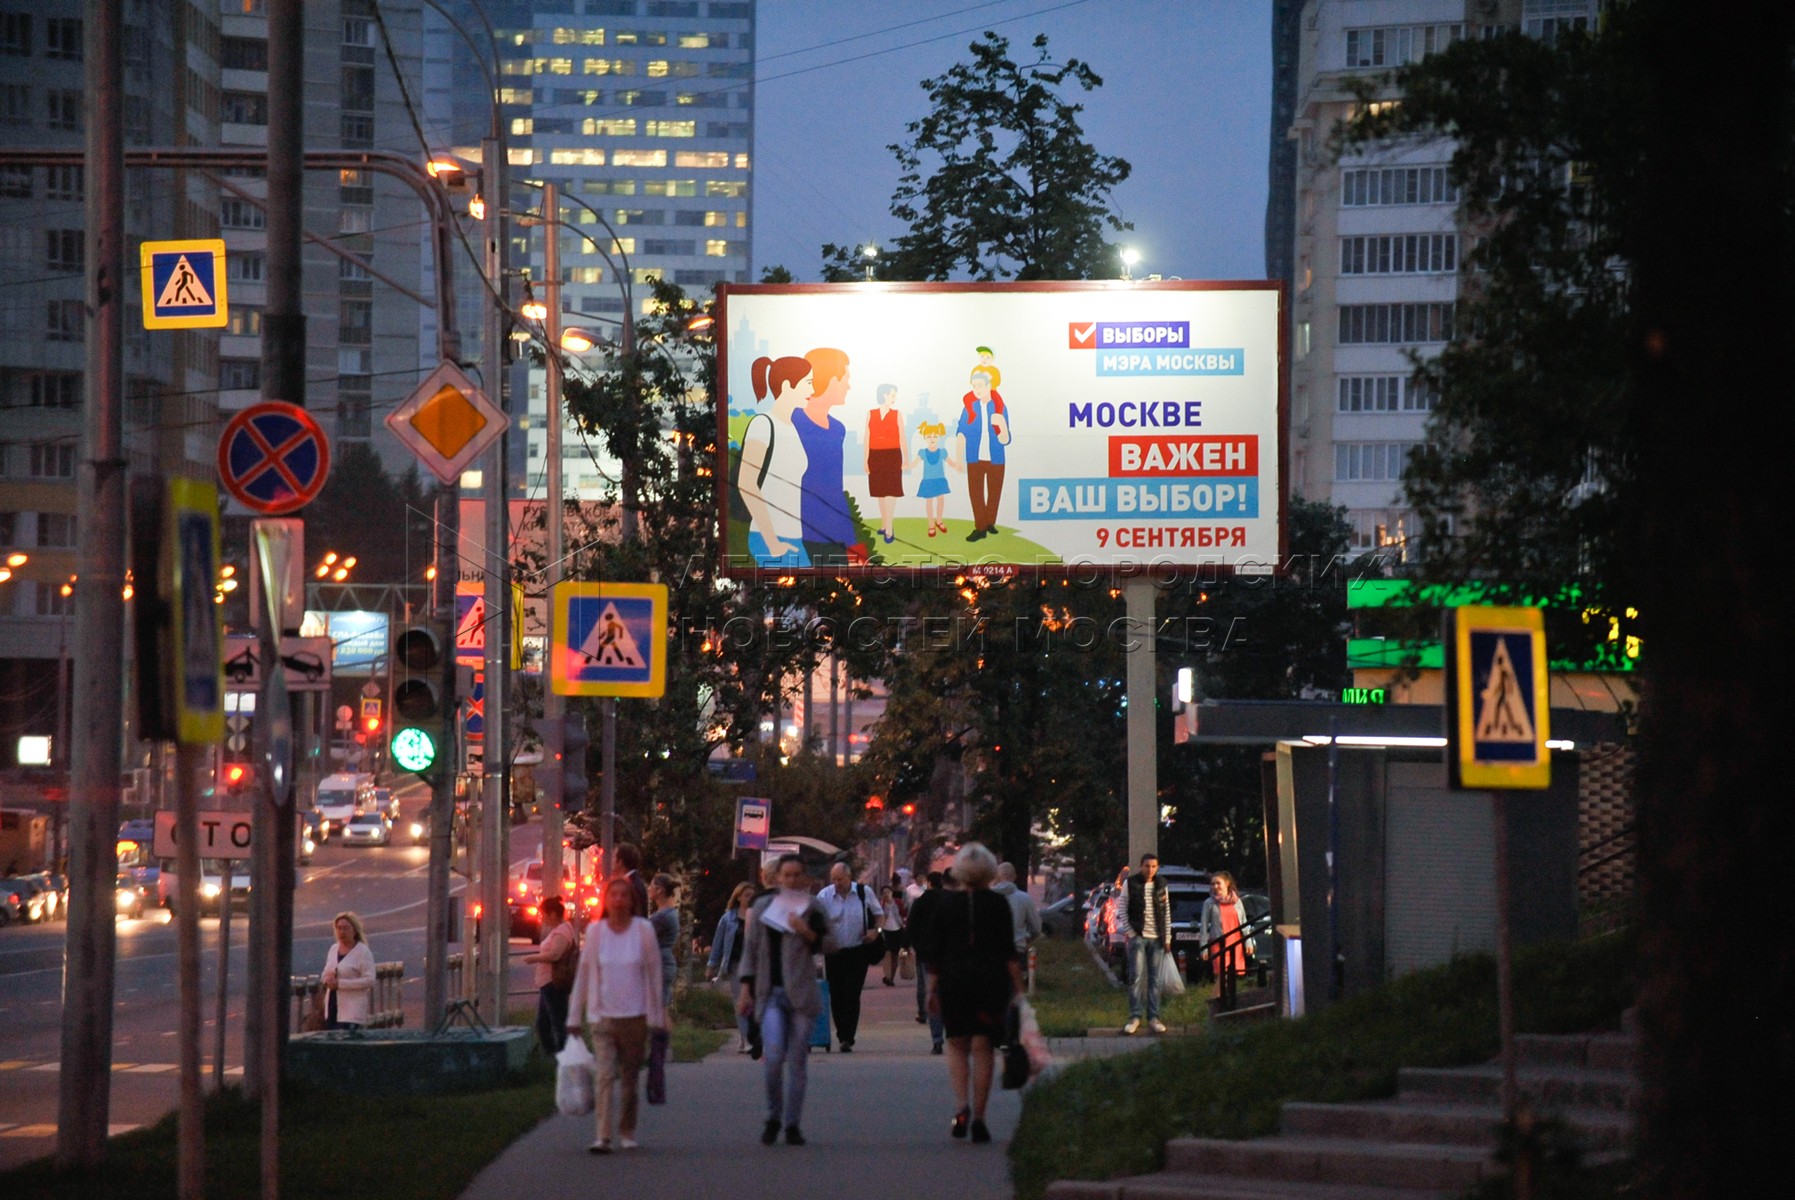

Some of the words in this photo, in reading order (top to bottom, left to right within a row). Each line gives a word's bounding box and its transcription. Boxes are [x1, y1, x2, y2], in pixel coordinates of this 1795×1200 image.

[1102, 326, 1184, 344] ВЫБОРЫ
[1103, 355, 1152, 371] МЭРА
[1156, 354, 1235, 370] МОСКВЫ
[1069, 401, 1202, 428] МОСКВЕ
[1121, 442, 1246, 471] ВАЖЕН
[1030, 485, 1106, 513] ВАШ
[1117, 484, 1246, 512] ВЫБОР!
[1096, 528, 1110, 548] 9
[1116, 526, 1246, 548] СЕНТЯБРЯ
